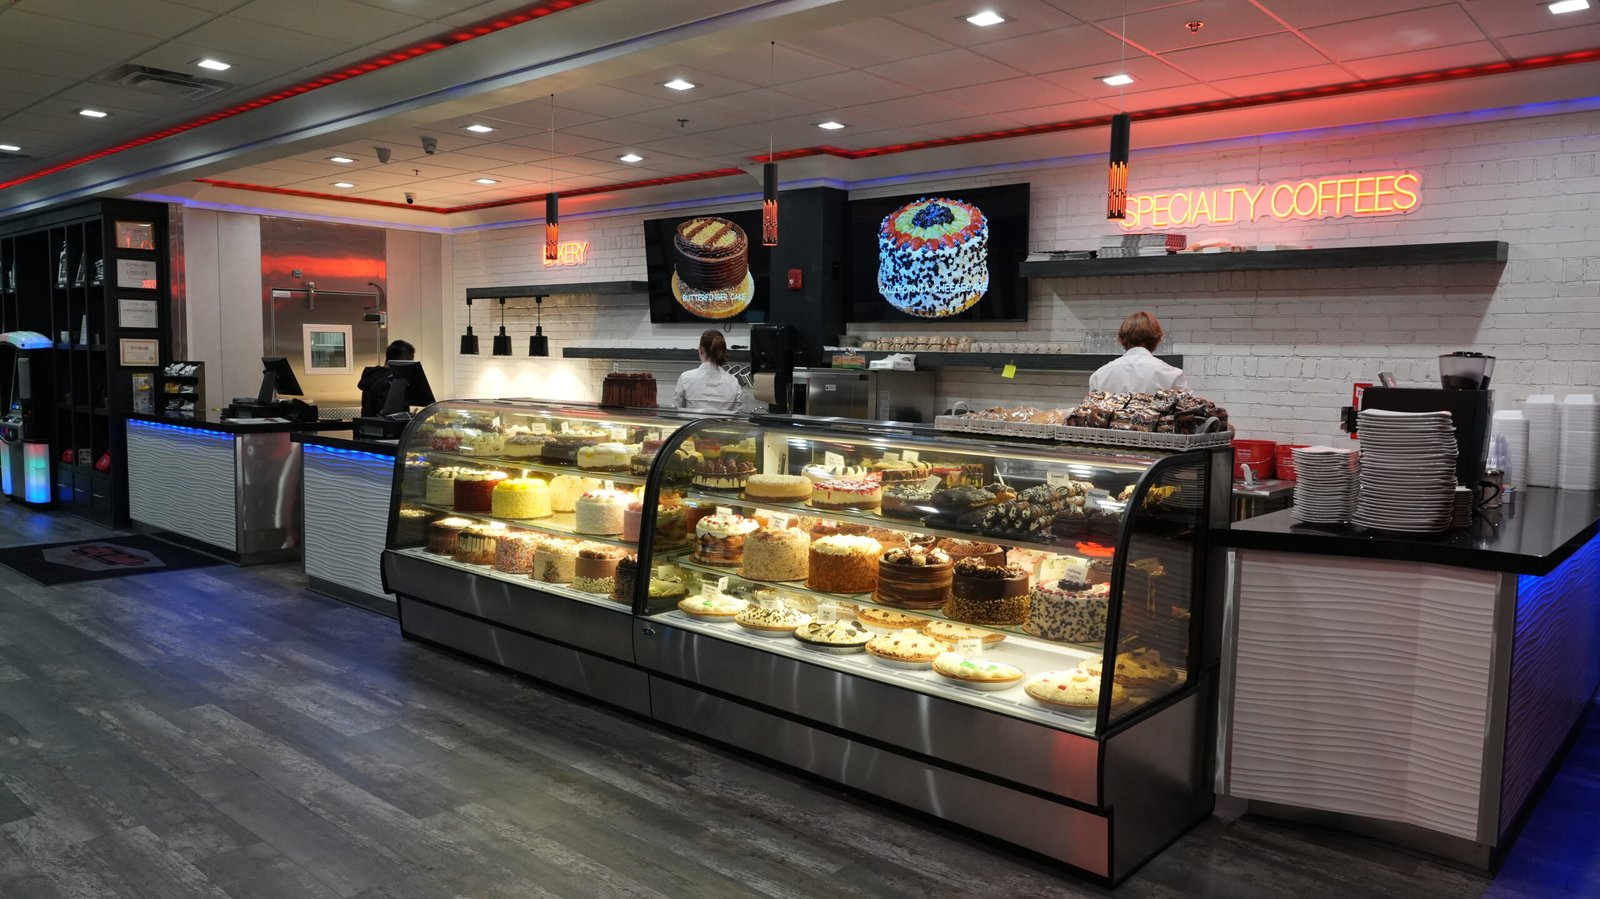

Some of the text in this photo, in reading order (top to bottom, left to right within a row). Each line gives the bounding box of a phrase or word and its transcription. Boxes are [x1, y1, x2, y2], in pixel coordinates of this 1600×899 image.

[1121, 173, 1418, 228] SPECIALTY COFFEES
[543, 241, 588, 265] BKERY
[879, 282, 988, 294] CALIFORNIA CHEESECAKE
[682, 293, 746, 302] BUTTERFINGER CAKE
